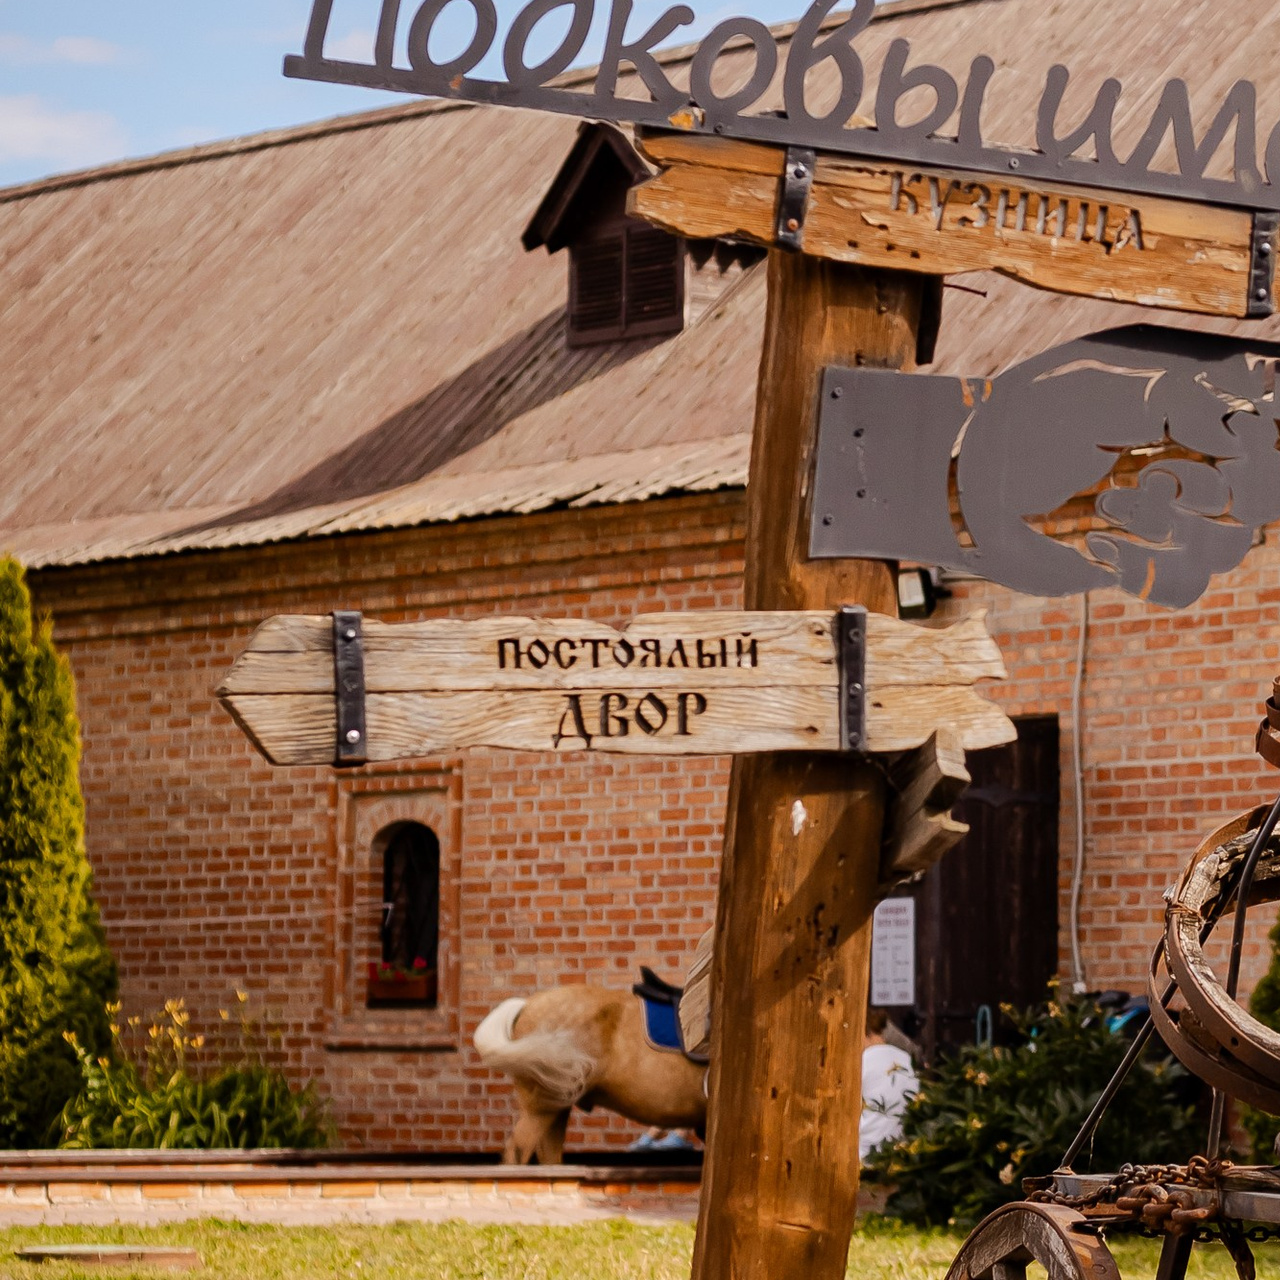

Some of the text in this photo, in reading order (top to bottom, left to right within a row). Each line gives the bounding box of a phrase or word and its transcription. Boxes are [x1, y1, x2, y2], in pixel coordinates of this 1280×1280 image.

[890, 170, 1145, 253] КУЗНИЦА
[498, 632, 758, 669] ПОСТОЯЛЫЙ
[552, 692, 707, 749] ДВОР
